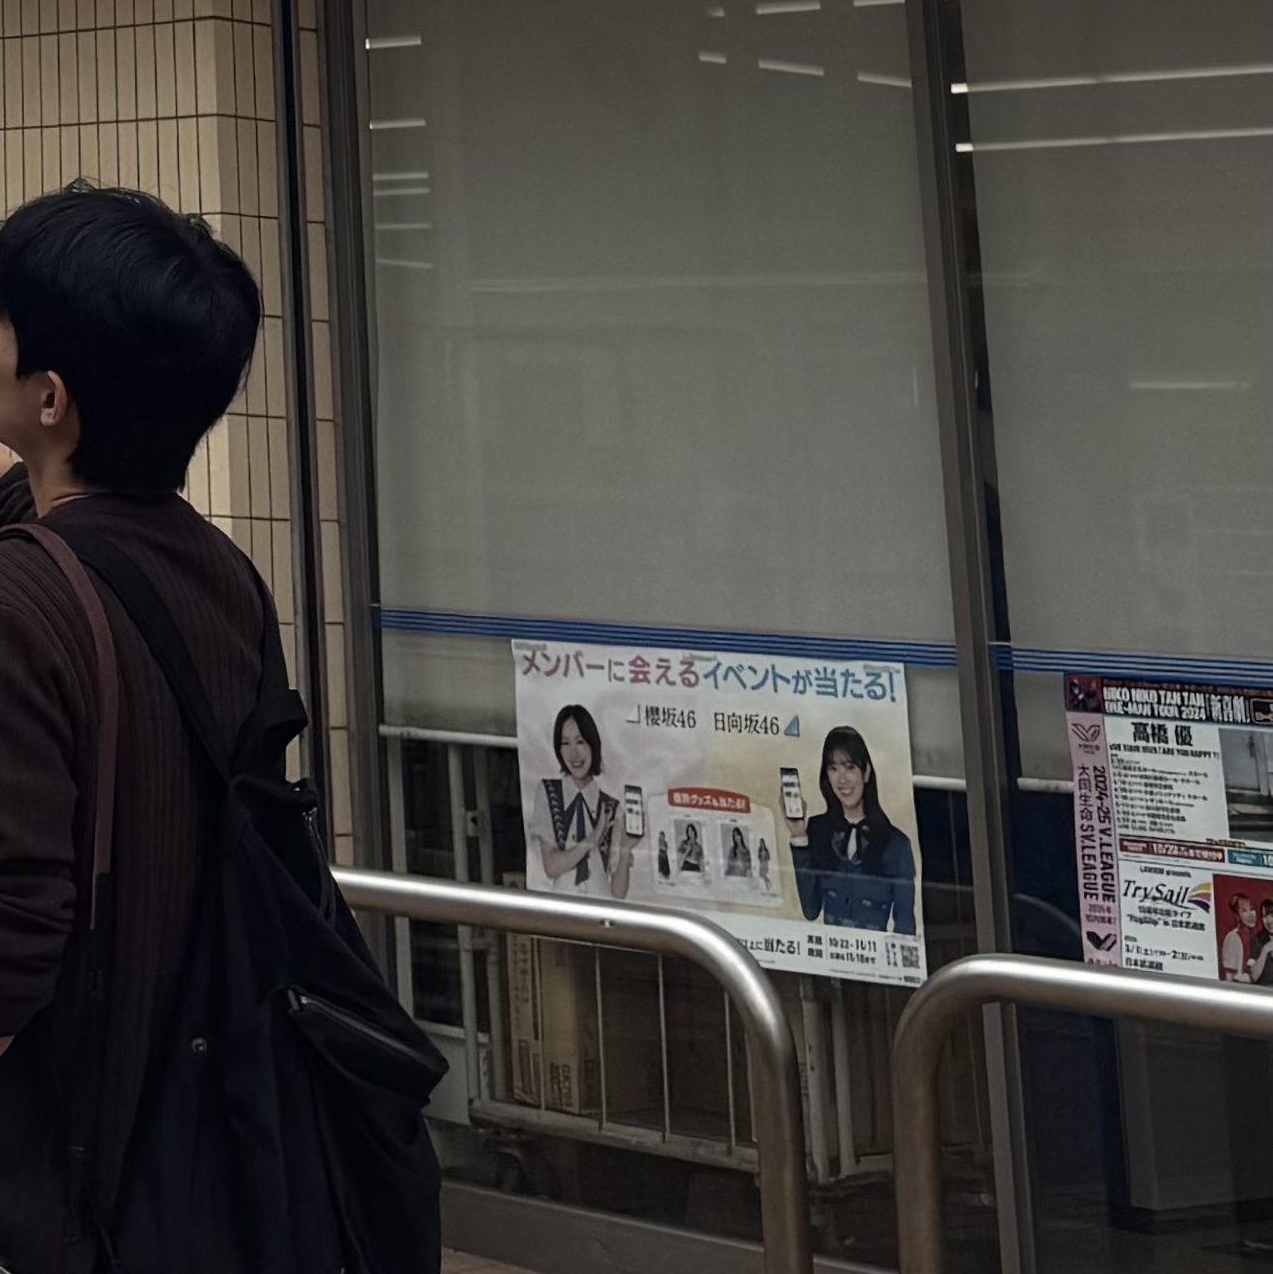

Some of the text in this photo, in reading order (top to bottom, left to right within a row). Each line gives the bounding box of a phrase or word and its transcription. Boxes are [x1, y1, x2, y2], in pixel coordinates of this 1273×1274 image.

[522, 649, 897, 703] メンバーに会えるイベントが当たる!
[713, 711, 780, 737] 日向坂46
[1094, 765, 1116, 904] 2024-25 V.LEAGUE
[1122, 879, 1191, 904] TrySail
